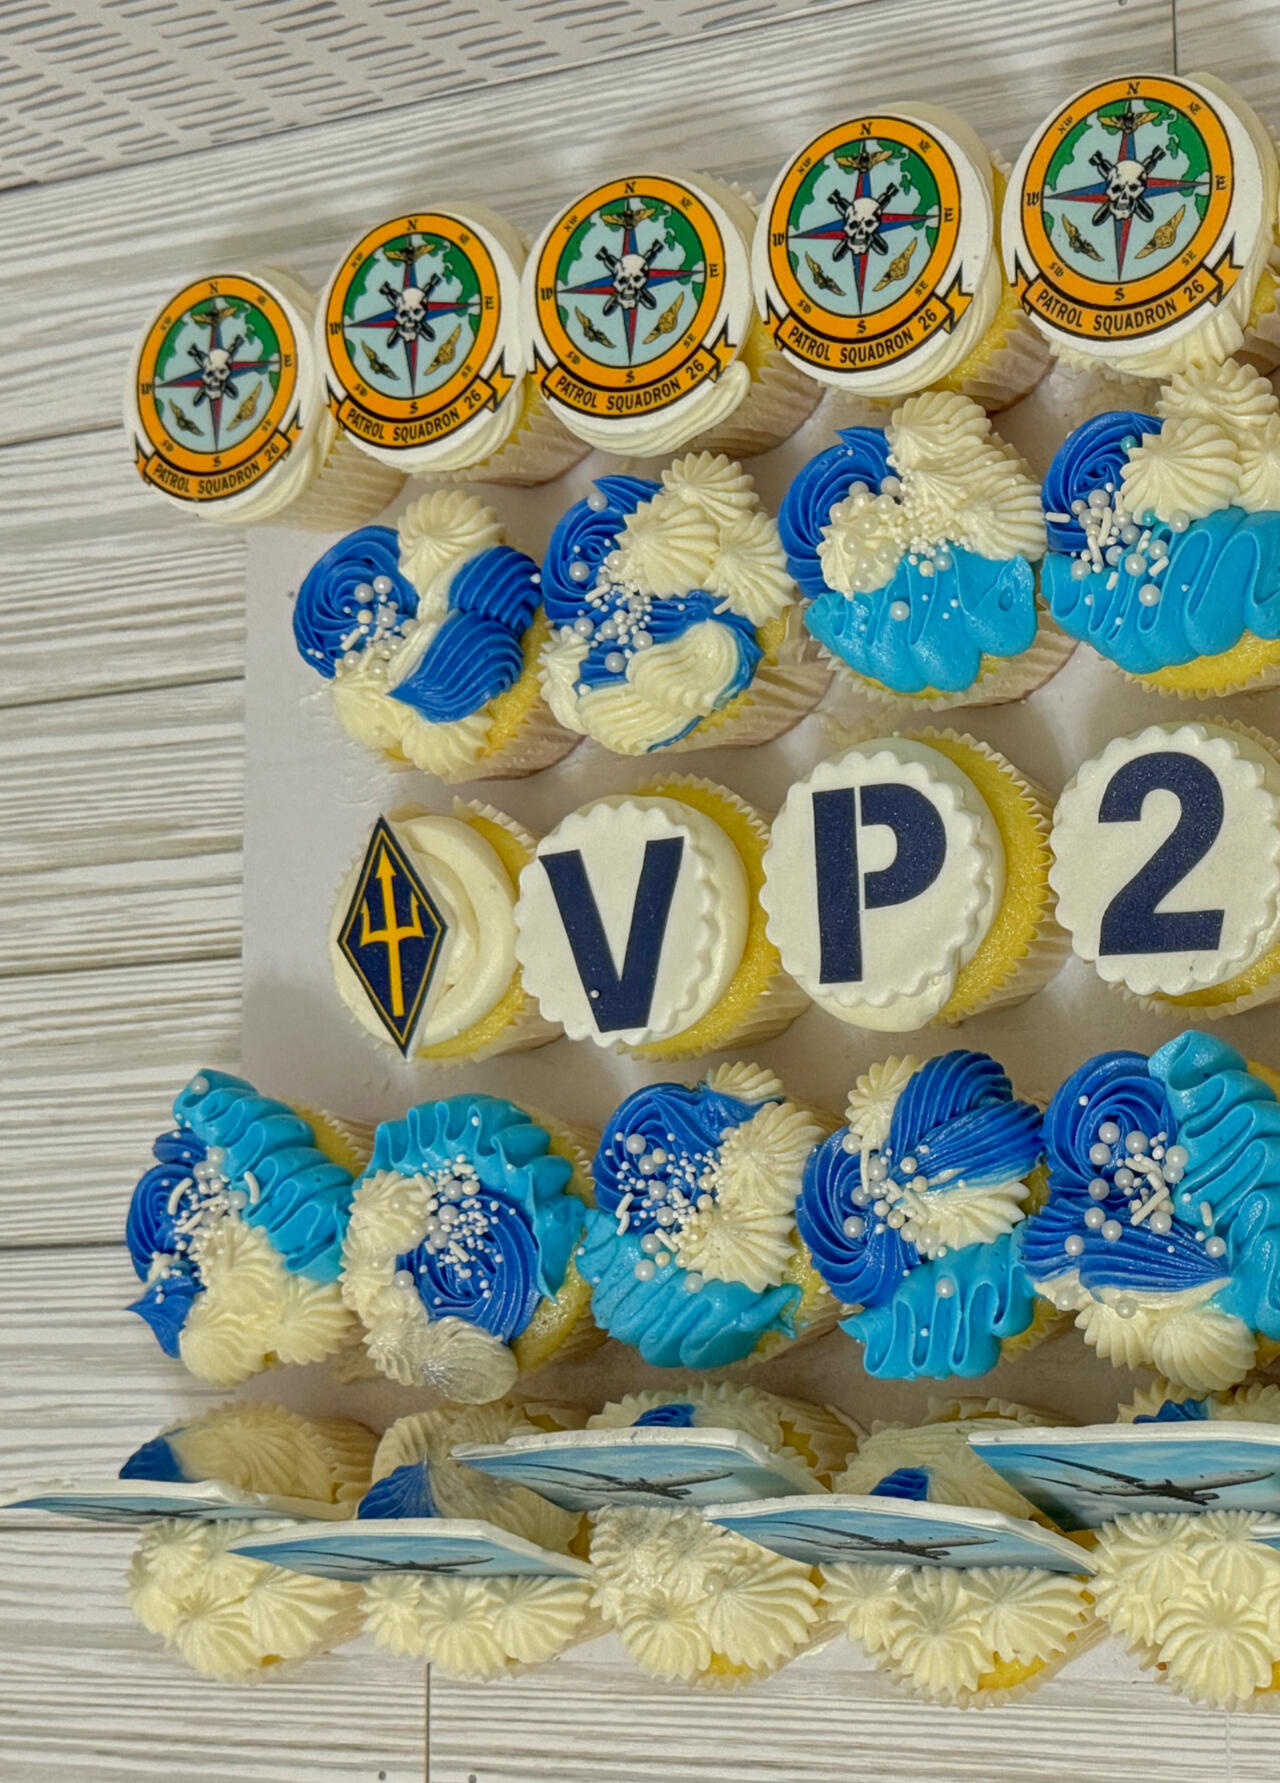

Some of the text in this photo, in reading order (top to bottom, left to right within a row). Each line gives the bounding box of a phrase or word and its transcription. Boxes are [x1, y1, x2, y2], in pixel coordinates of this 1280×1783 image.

[1126, 83, 1140, 95] N
[860, 122, 873, 135] N
[624, 182, 636, 193] N
[1216, 175, 1226, 190] E
[944, 208, 953, 222] E
[407, 219, 418, 230] N
[1182, 253, 1196, 267] SE
[709, 264, 719, 277] E
[209, 282, 219, 294] N
[1114, 287, 1125, 302] S
[485, 296, 494, 310] E
[1036, 280, 1204, 334] PATROL SQUADRON 26
[857, 320, 866, 334] S
[788, 309, 936, 366] PATROL SQUADRON 26
[625, 371, 635, 383] S
[555, 359, 704, 412] PATROL SQUADRON 26
[409, 402, 418, 413] S
[347, 390, 481, 441] PATROL SQUADRON 26
[213, 456, 221, 467] S
[154, 443, 279, 495] PATROL SQUADRON 26
